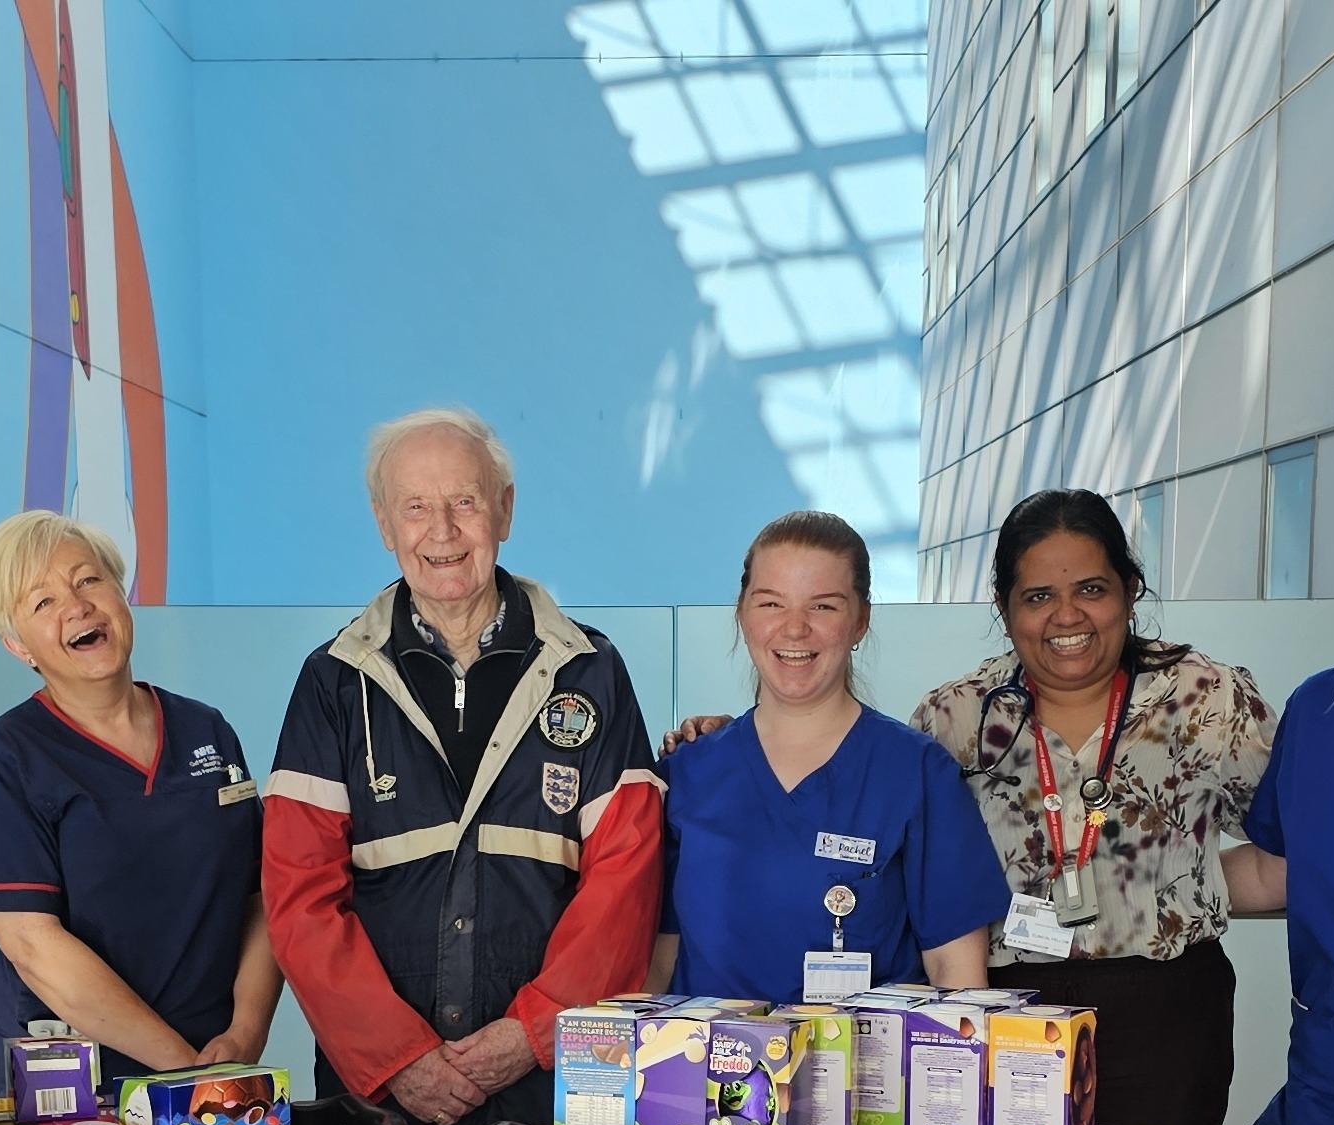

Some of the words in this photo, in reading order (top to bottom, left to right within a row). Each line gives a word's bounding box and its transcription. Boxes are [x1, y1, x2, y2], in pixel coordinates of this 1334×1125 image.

[580, 1020, 614, 1029] ORANGE
[561, 1027, 604, 1035] CHOCOLATE
[560, 1033, 619, 1044] EXPLODING
[712, 1040, 737, 1050] DAIRY
[712, 1047, 733, 1056] MILK
[711, 1056, 750, 1072] Freddo
